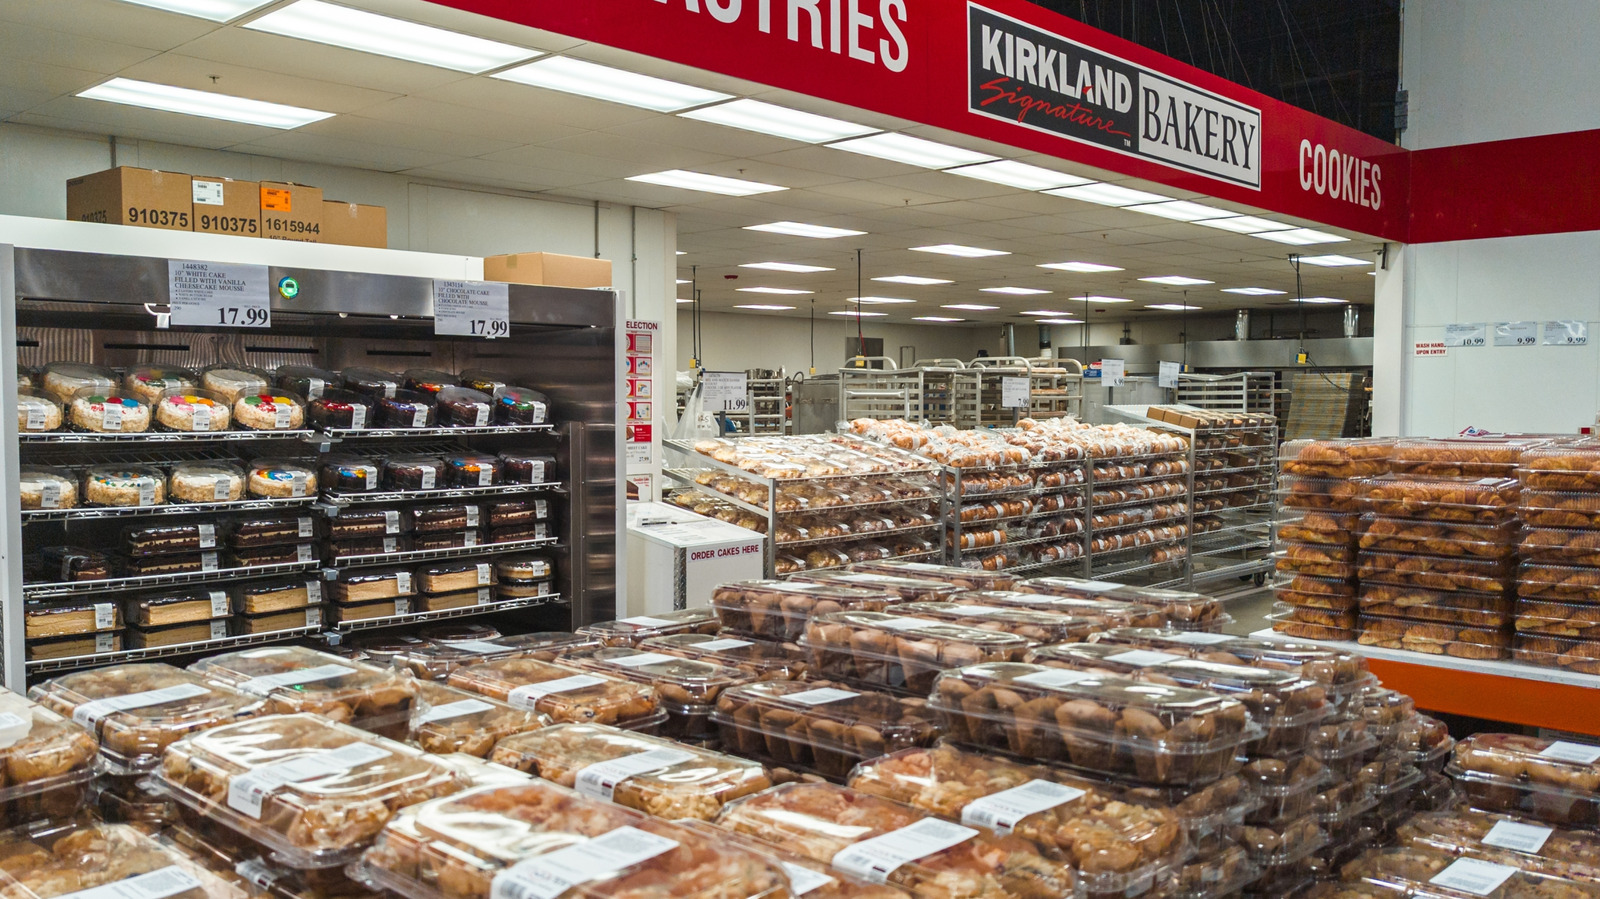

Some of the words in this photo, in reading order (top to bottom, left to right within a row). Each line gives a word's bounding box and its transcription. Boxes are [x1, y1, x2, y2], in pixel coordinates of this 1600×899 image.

[656, 0, 908, 72] RIES
[982, 24, 1133, 114] KIRKLAND
[980, 77, 1132, 138] Signature
[1142, 86, 1256, 170] BAKERY
[1300, 138, 1382, 210] COOKIES
[128, 208, 188, 227] 910375
[201, 215, 257, 233] 910375
[266, 218, 320, 234] 1615944
[218, 307, 268, 325] 17.99
[470, 320, 507, 335] 17.99
[626, 321, 658, 330] ELECTION
[724, 399, 746, 410] 11.99
[691, 550, 715, 561] ORDER
[718, 547, 740, 557] CAKES
[742, 544, 759, 553] HERE
